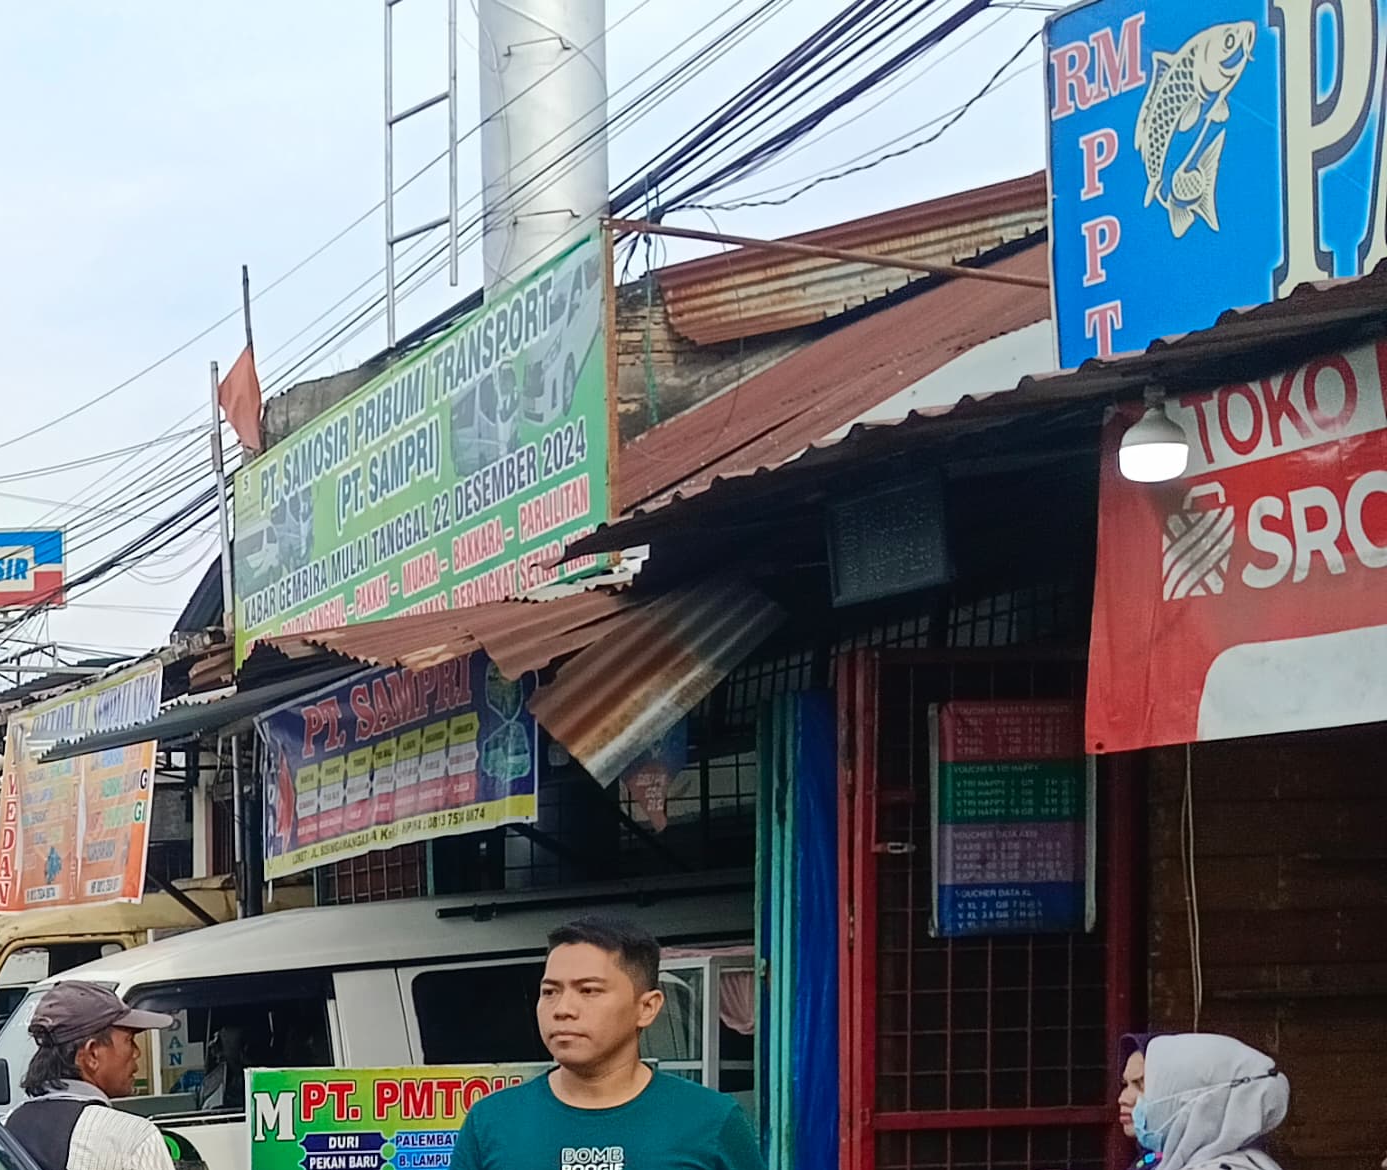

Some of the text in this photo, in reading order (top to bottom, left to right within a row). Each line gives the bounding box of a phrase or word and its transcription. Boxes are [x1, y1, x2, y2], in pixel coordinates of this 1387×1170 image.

[1051, 12, 1146, 121] RM
[261, 275, 553, 511] PT. SAMOSIR PRIBUMI TRANSPORT
[1179, 354, 1358, 465] TOKO
[244, 420, 586, 629] KABAR GEMBIRA MULAI TANGGAL 22 DESEMBER 2024
[337, 416, 441, 533] (PT. SAMPRI)
[355, 573, 389, 618] PAKKAT
[403, 548, 439, 597] MUARA
[453, 518, 504, 573] BAKKARA
[519, 476, 589, 541] PARLILITAN
[301, 697, 346, 758] PT.
[351, 655, 473, 741] SAMPRI
[301, 1081, 361, 1121] PT.
[328, 1136, 359, 1149] DURI
[561, 1146, 624, 1164] BOMB
[309, 1157, 346, 1170] PEKAN
[349, 1156, 378, 1168] BARU
[399, 1155, 409, 1166] B.
